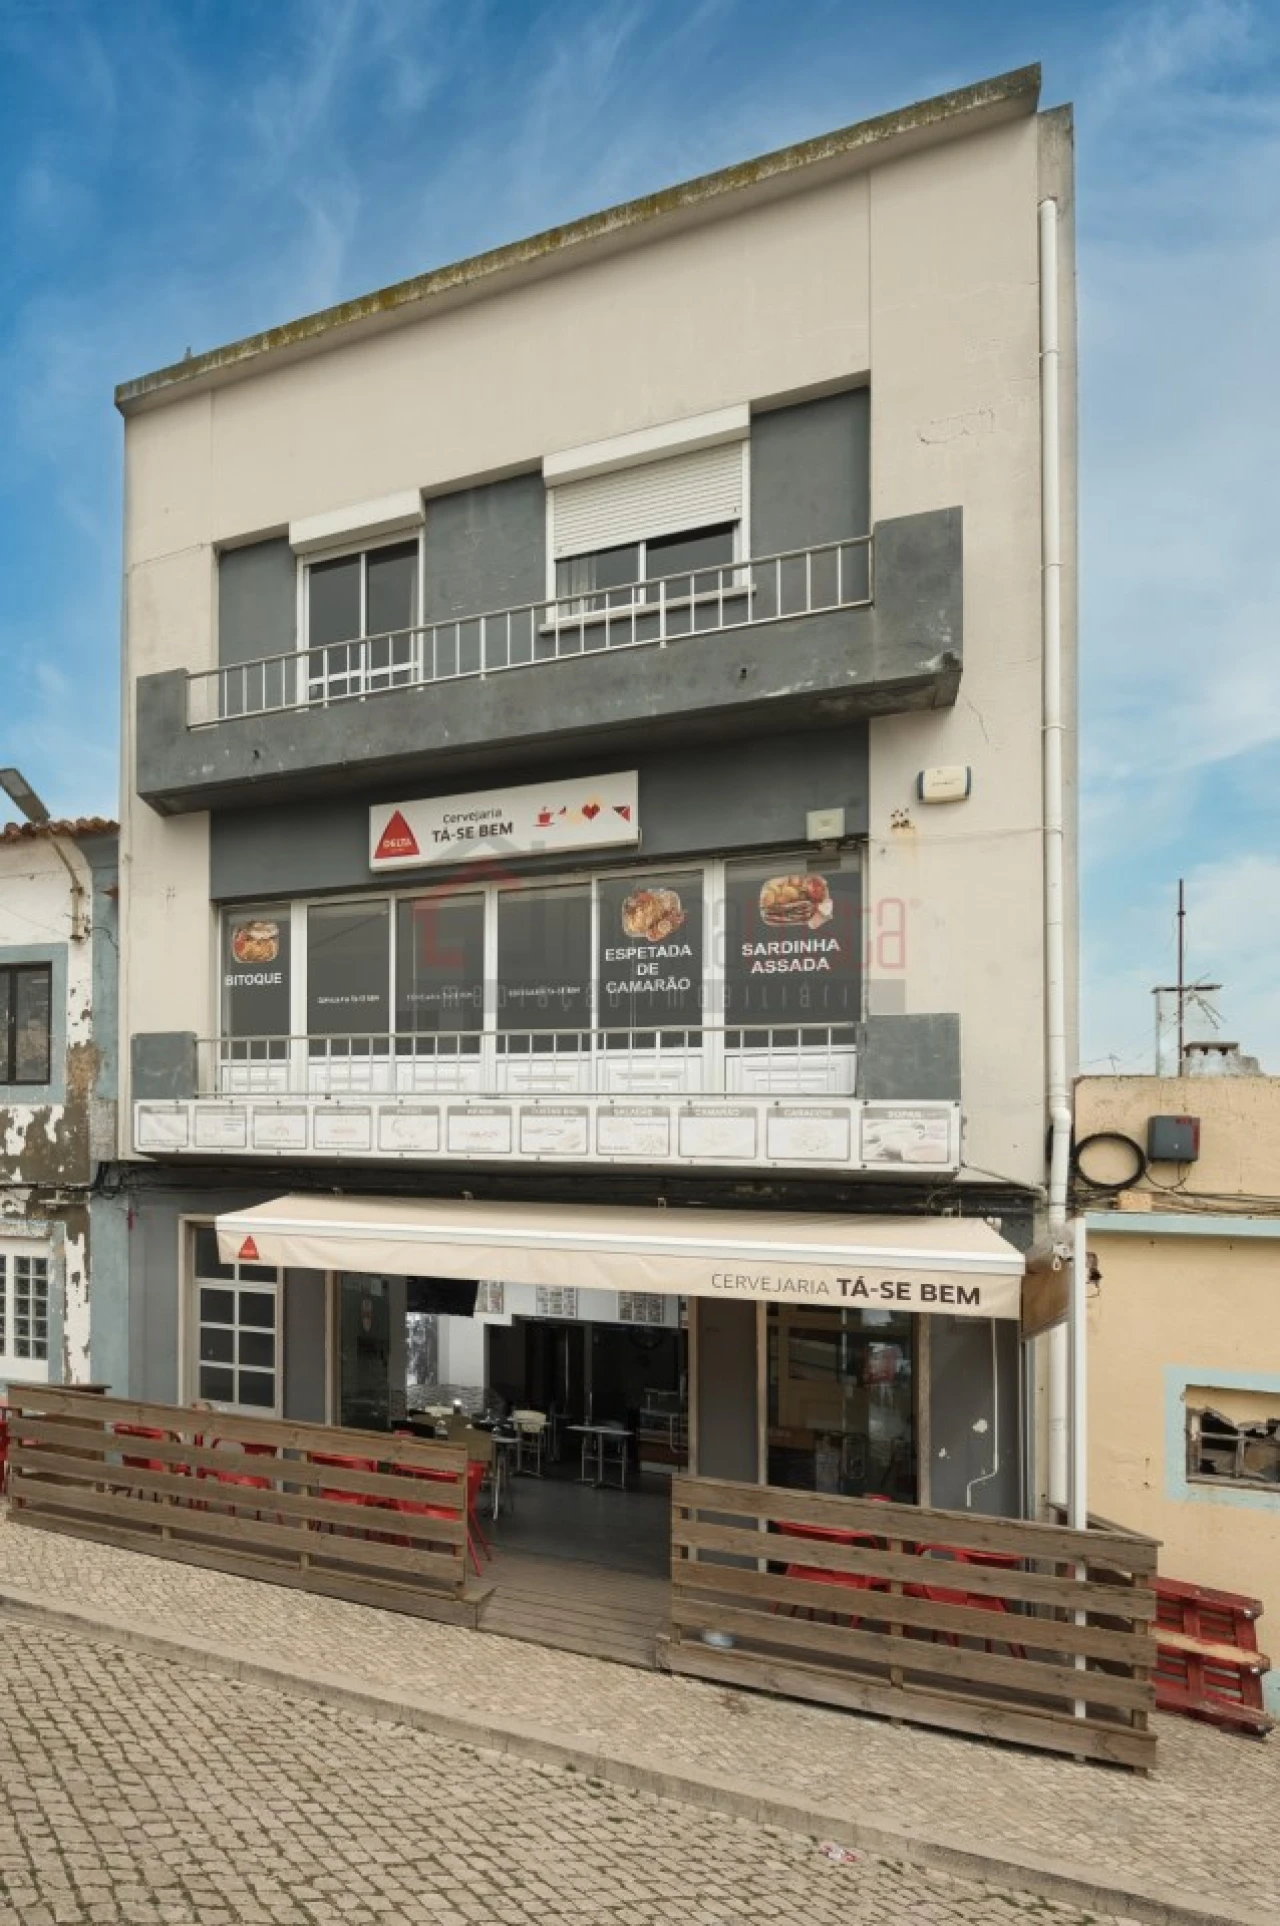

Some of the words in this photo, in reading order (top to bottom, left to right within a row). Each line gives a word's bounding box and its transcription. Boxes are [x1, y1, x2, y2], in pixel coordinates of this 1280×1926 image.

[442, 808, 503, 824] Cervejaria
[432, 825, 474, 843] TÁ-SE
[479, 821, 514, 838] BEM
[382, 838, 412, 849] DELTA
[605, 944, 693, 962] ESPETADA
[741, 938, 841, 956] SARDINHA
[637, 963, 659, 977] DE
[751, 956, 831, 974] ASSADA
[224, 972, 283, 986] BITOQUE
[605, 976, 691, 994] CAMARÃO
[711, 1273, 830, 1295] CERVEJARIA
[836, 1275, 912, 1301] TÁ-SE
[920, 1283, 980, 1306] BEM
